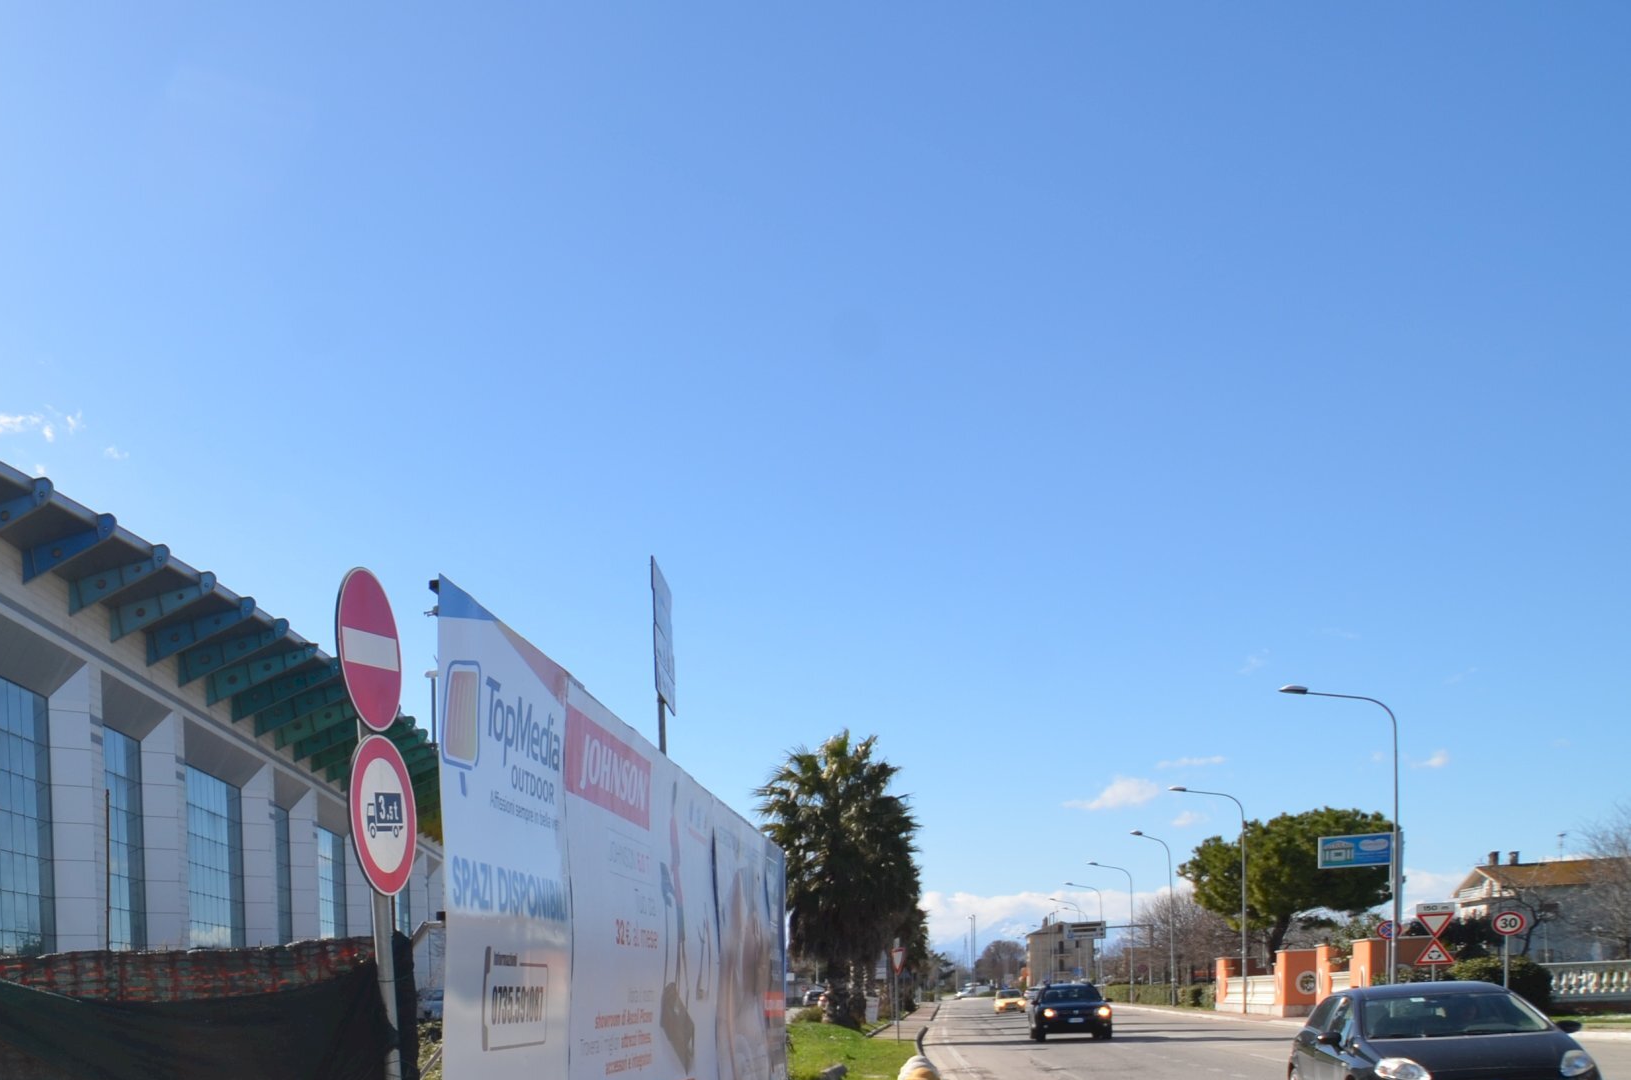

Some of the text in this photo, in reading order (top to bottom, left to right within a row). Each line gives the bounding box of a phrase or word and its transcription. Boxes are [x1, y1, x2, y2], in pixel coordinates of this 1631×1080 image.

[486, 676, 560, 771] TopMedia
[511, 765, 554, 805] OUTDOOR
[580, 733, 648, 811] JOHNSON
[452, 855, 493, 912] SPAZI
[497, 867, 567, 923] DISPONIBILI
[1500, 918, 1518, 929] 30
[491, 985, 544, 1025] 0735.591087
